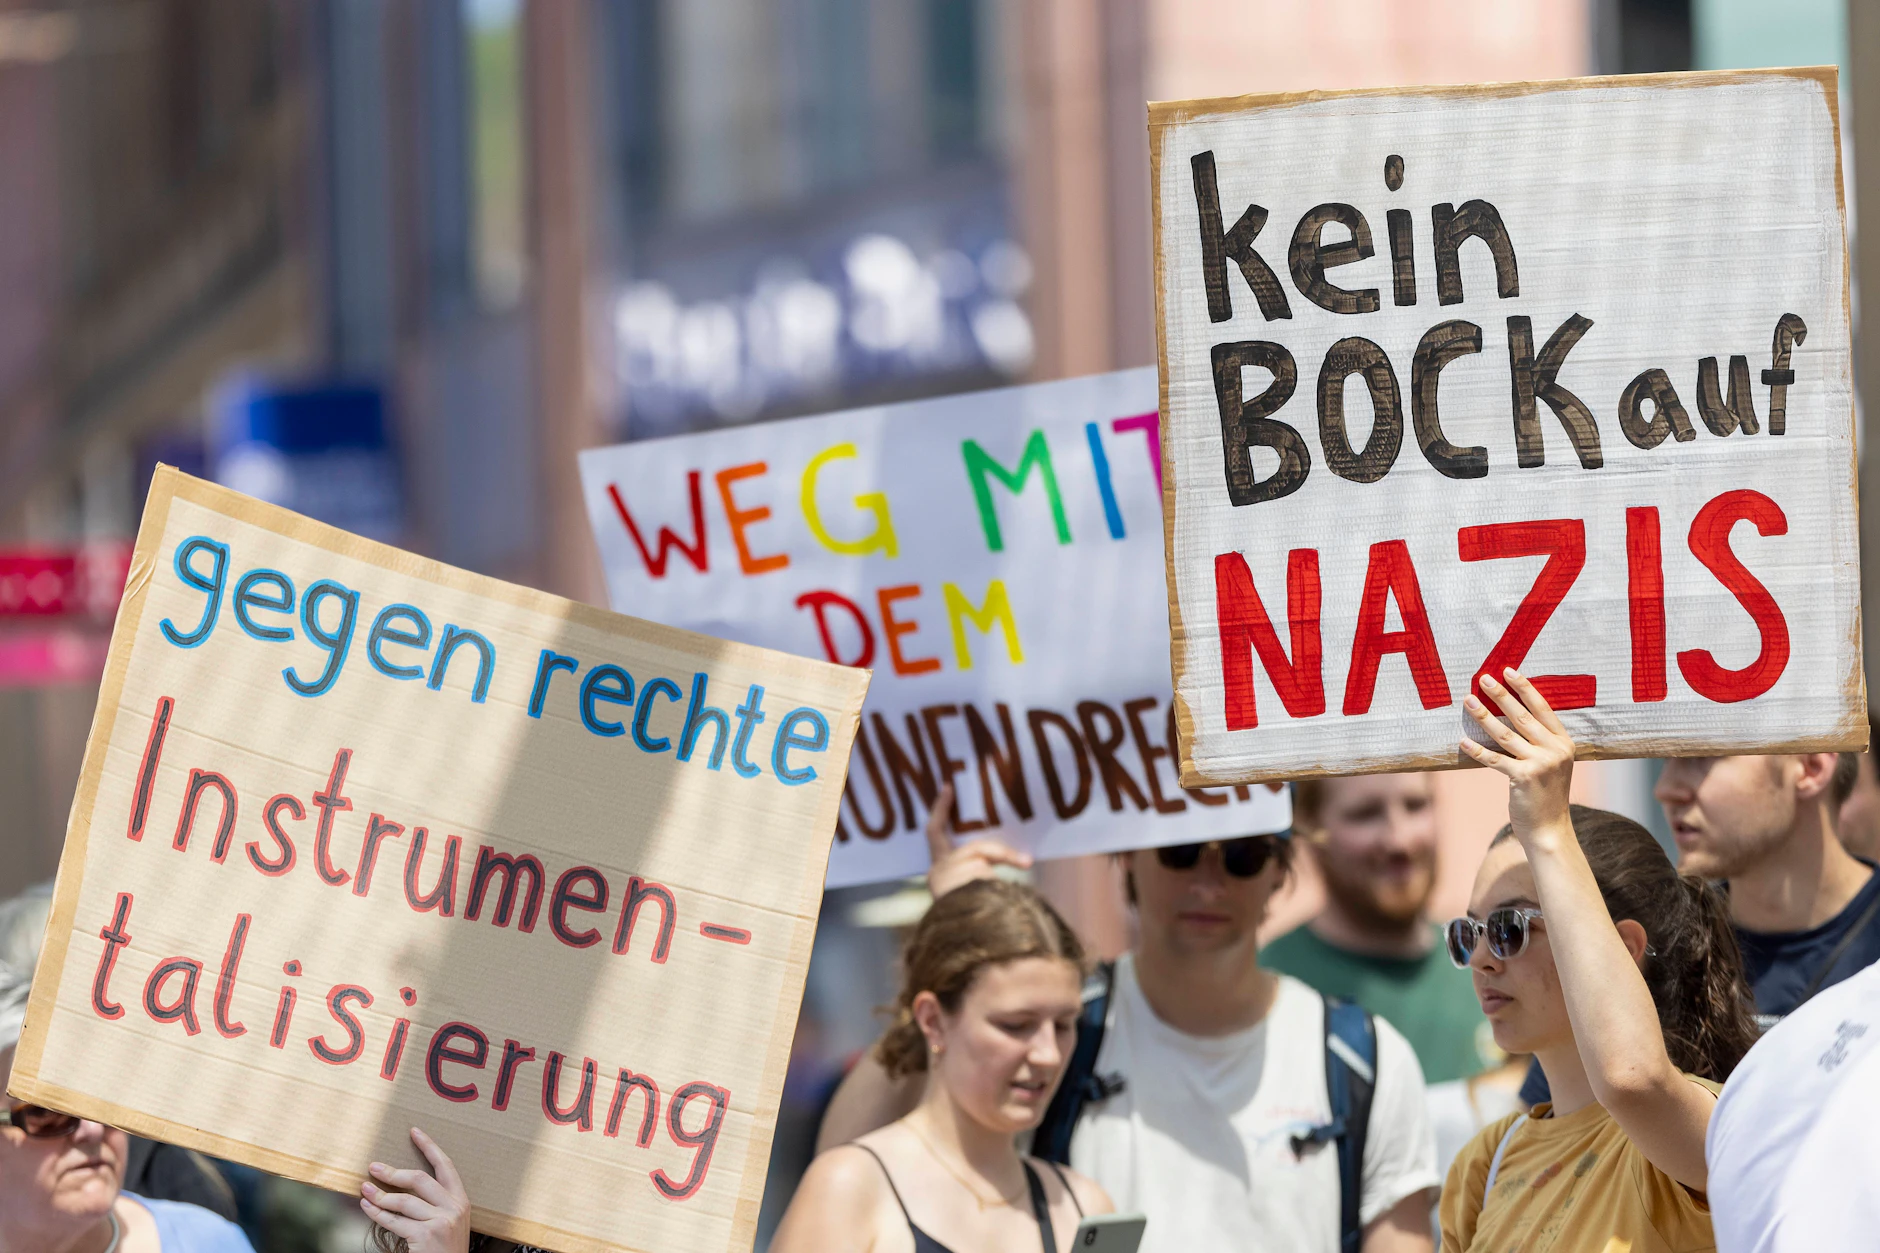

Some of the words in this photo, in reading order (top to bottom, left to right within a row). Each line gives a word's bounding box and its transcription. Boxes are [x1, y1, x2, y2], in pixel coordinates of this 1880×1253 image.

[1190, 149, 1520, 323] kein
[607, 442, 899, 579] WEG
[961, 411, 1164, 552] MIT
[1210, 313, 1604, 507] BOCK
[1617, 312, 1807, 451] auf
[159, 535, 496, 704] gegen
[527, 649, 830, 786] rechte
[795, 580, 1024, 677] DEM
[1214, 489, 1791, 731] NAZIS
[126, 695, 752, 965] Instrumen-
[90, 892, 732, 1201] talisierung
